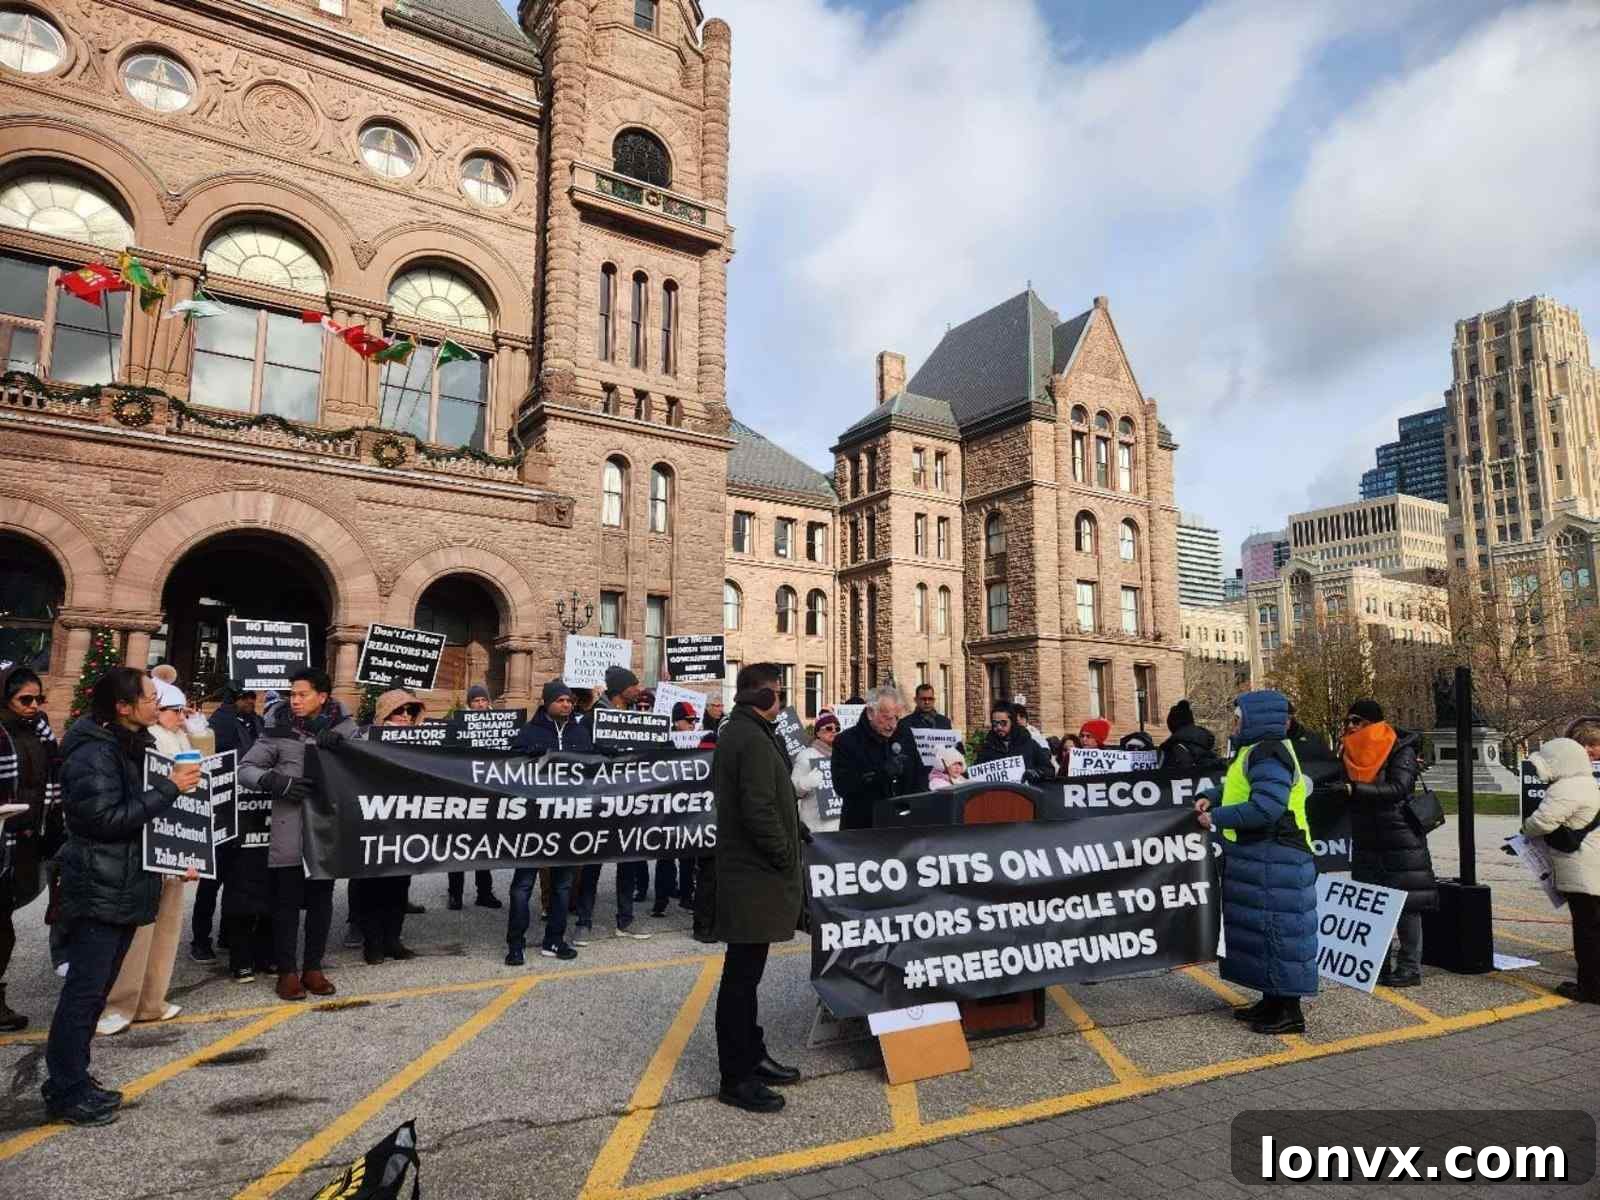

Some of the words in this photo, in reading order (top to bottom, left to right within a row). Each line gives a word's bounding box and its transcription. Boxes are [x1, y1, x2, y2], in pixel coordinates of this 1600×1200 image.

[464, 712, 518, 722] REALTORS
[468, 721, 513, 730] DEMAND
[381, 729, 446, 741] REALTORS
[456, 730, 499, 739] JUSTICE
[596, 729, 650, 741] REALTORS
[1072, 750, 1098, 758] WHO
[1102, 752, 1128, 760] WILL
[1082, 758, 1116, 769] PAY
[471, 759, 585, 786] FAMILIES
[592, 759, 711, 785] AFFECTED
[970, 758, 1022, 777] UNFREEZE
[985, 770, 1009, 782] OUR
[358, 795, 490, 820] WHERE
[496, 797, 527, 820] IS
[536, 796, 593, 820] THE
[599, 790, 715, 819] JUSTICE?
[1063, 780, 1162, 808] RECO
[152, 817, 175, 836] Take
[175, 822, 207, 844] Control
[360, 832, 561, 865] THOUSANDS
[569, 830, 610, 855] OF
[618, 823, 718, 852] VICTIMS
[155, 847, 177, 867] Take
[809, 858, 908, 898] RECO
[917, 852, 994, 887] SITS
[1000, 848, 1053, 880] ON
[1055, 833, 1207, 875] MILLIONS
[1325, 882, 1390, 916] FREE
[821, 908, 972, 952] REALTORS
[977, 892, 1117, 931] STRUGGLE
[1118, 888, 1156, 914] TO
[1160, 881, 1210, 909] EAT
[1320, 914, 1372, 948] OUR
[903, 928, 1158, 989] #FREEOURFUNDS
